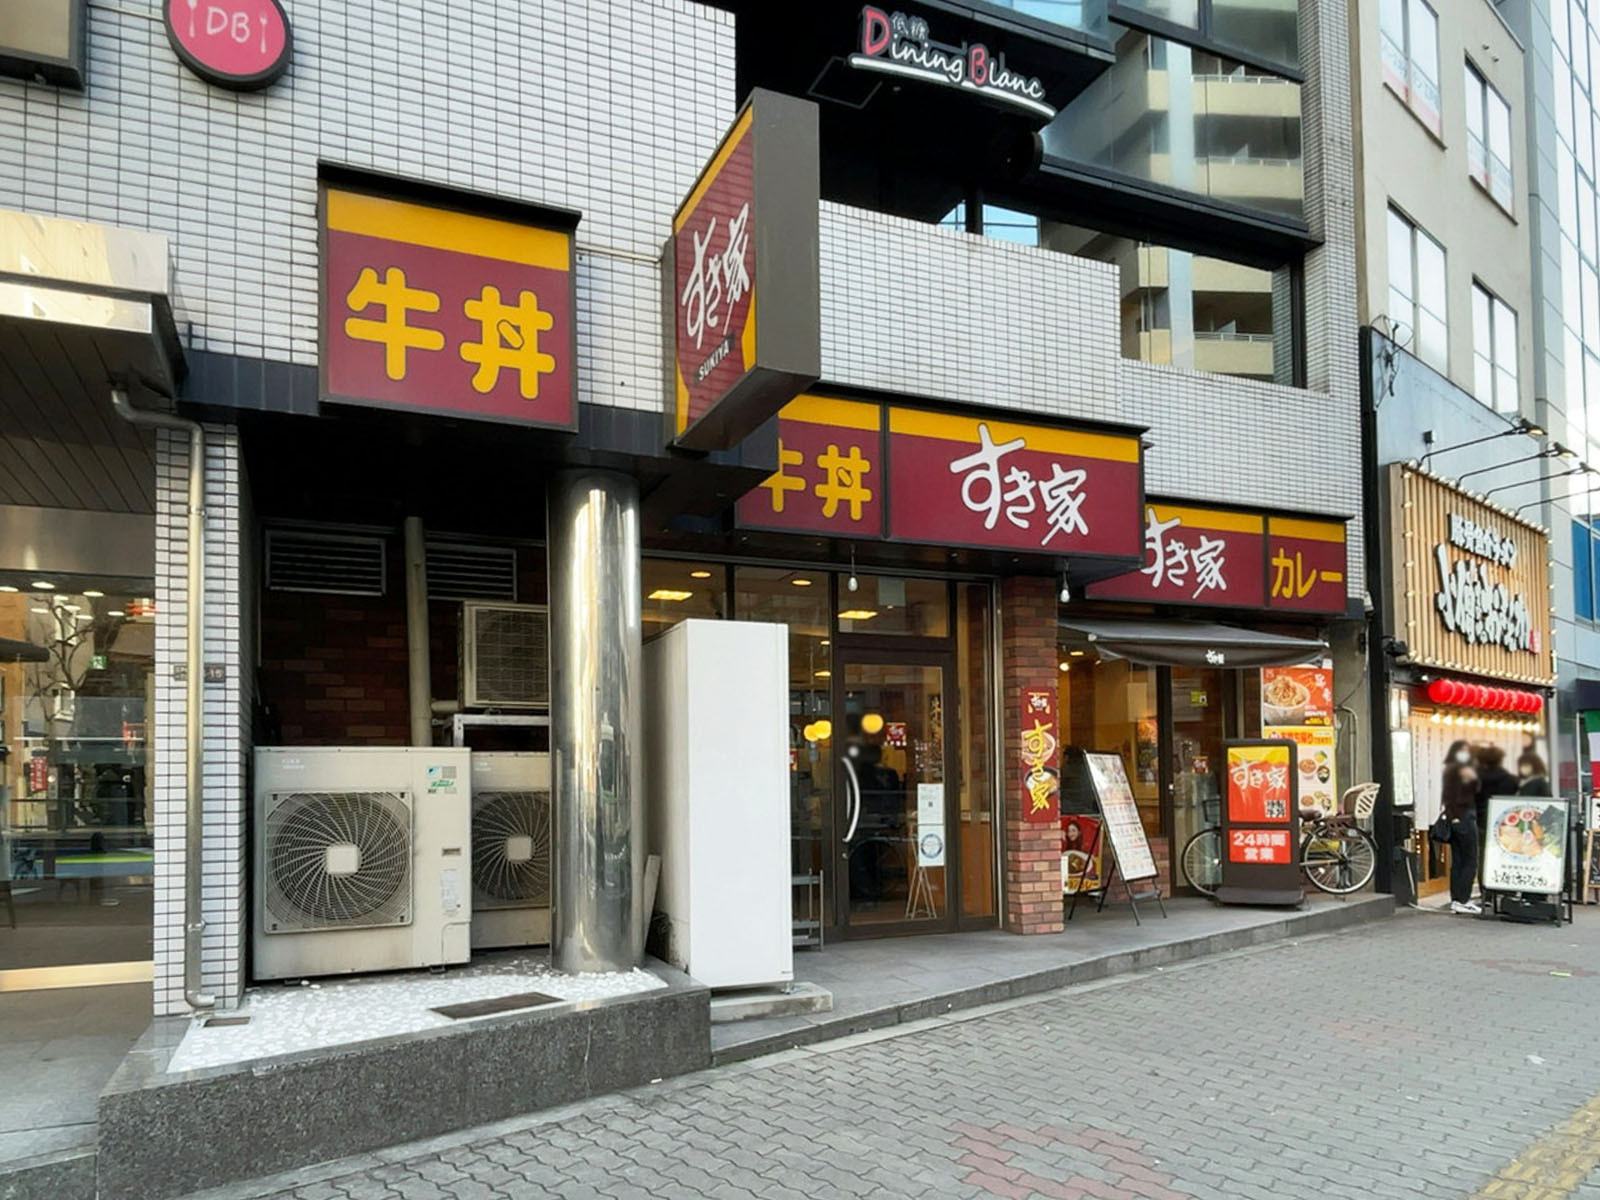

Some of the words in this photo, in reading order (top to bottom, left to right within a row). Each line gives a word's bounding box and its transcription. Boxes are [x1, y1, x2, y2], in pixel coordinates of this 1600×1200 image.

[206, 6, 250, 43] DB
[865, 8, 964, 82] Dining
[970, 46, 1042, 98] Blanc
[681, 202, 750, 350] すき家
[345, 267, 555, 399] 牛丼
[698, 338, 730, 381] SUKIYA
[949, 422, 1089, 546] すき家
[1141, 508, 1227, 599] すき家
[1271, 547, 1343, 599] カレー
[1023, 719, 1053, 814] すき家
[1230, 760, 1288, 794] すき家
[1233, 832, 1287, 847] 24時間
[1244, 847, 1275, 861] 営業
